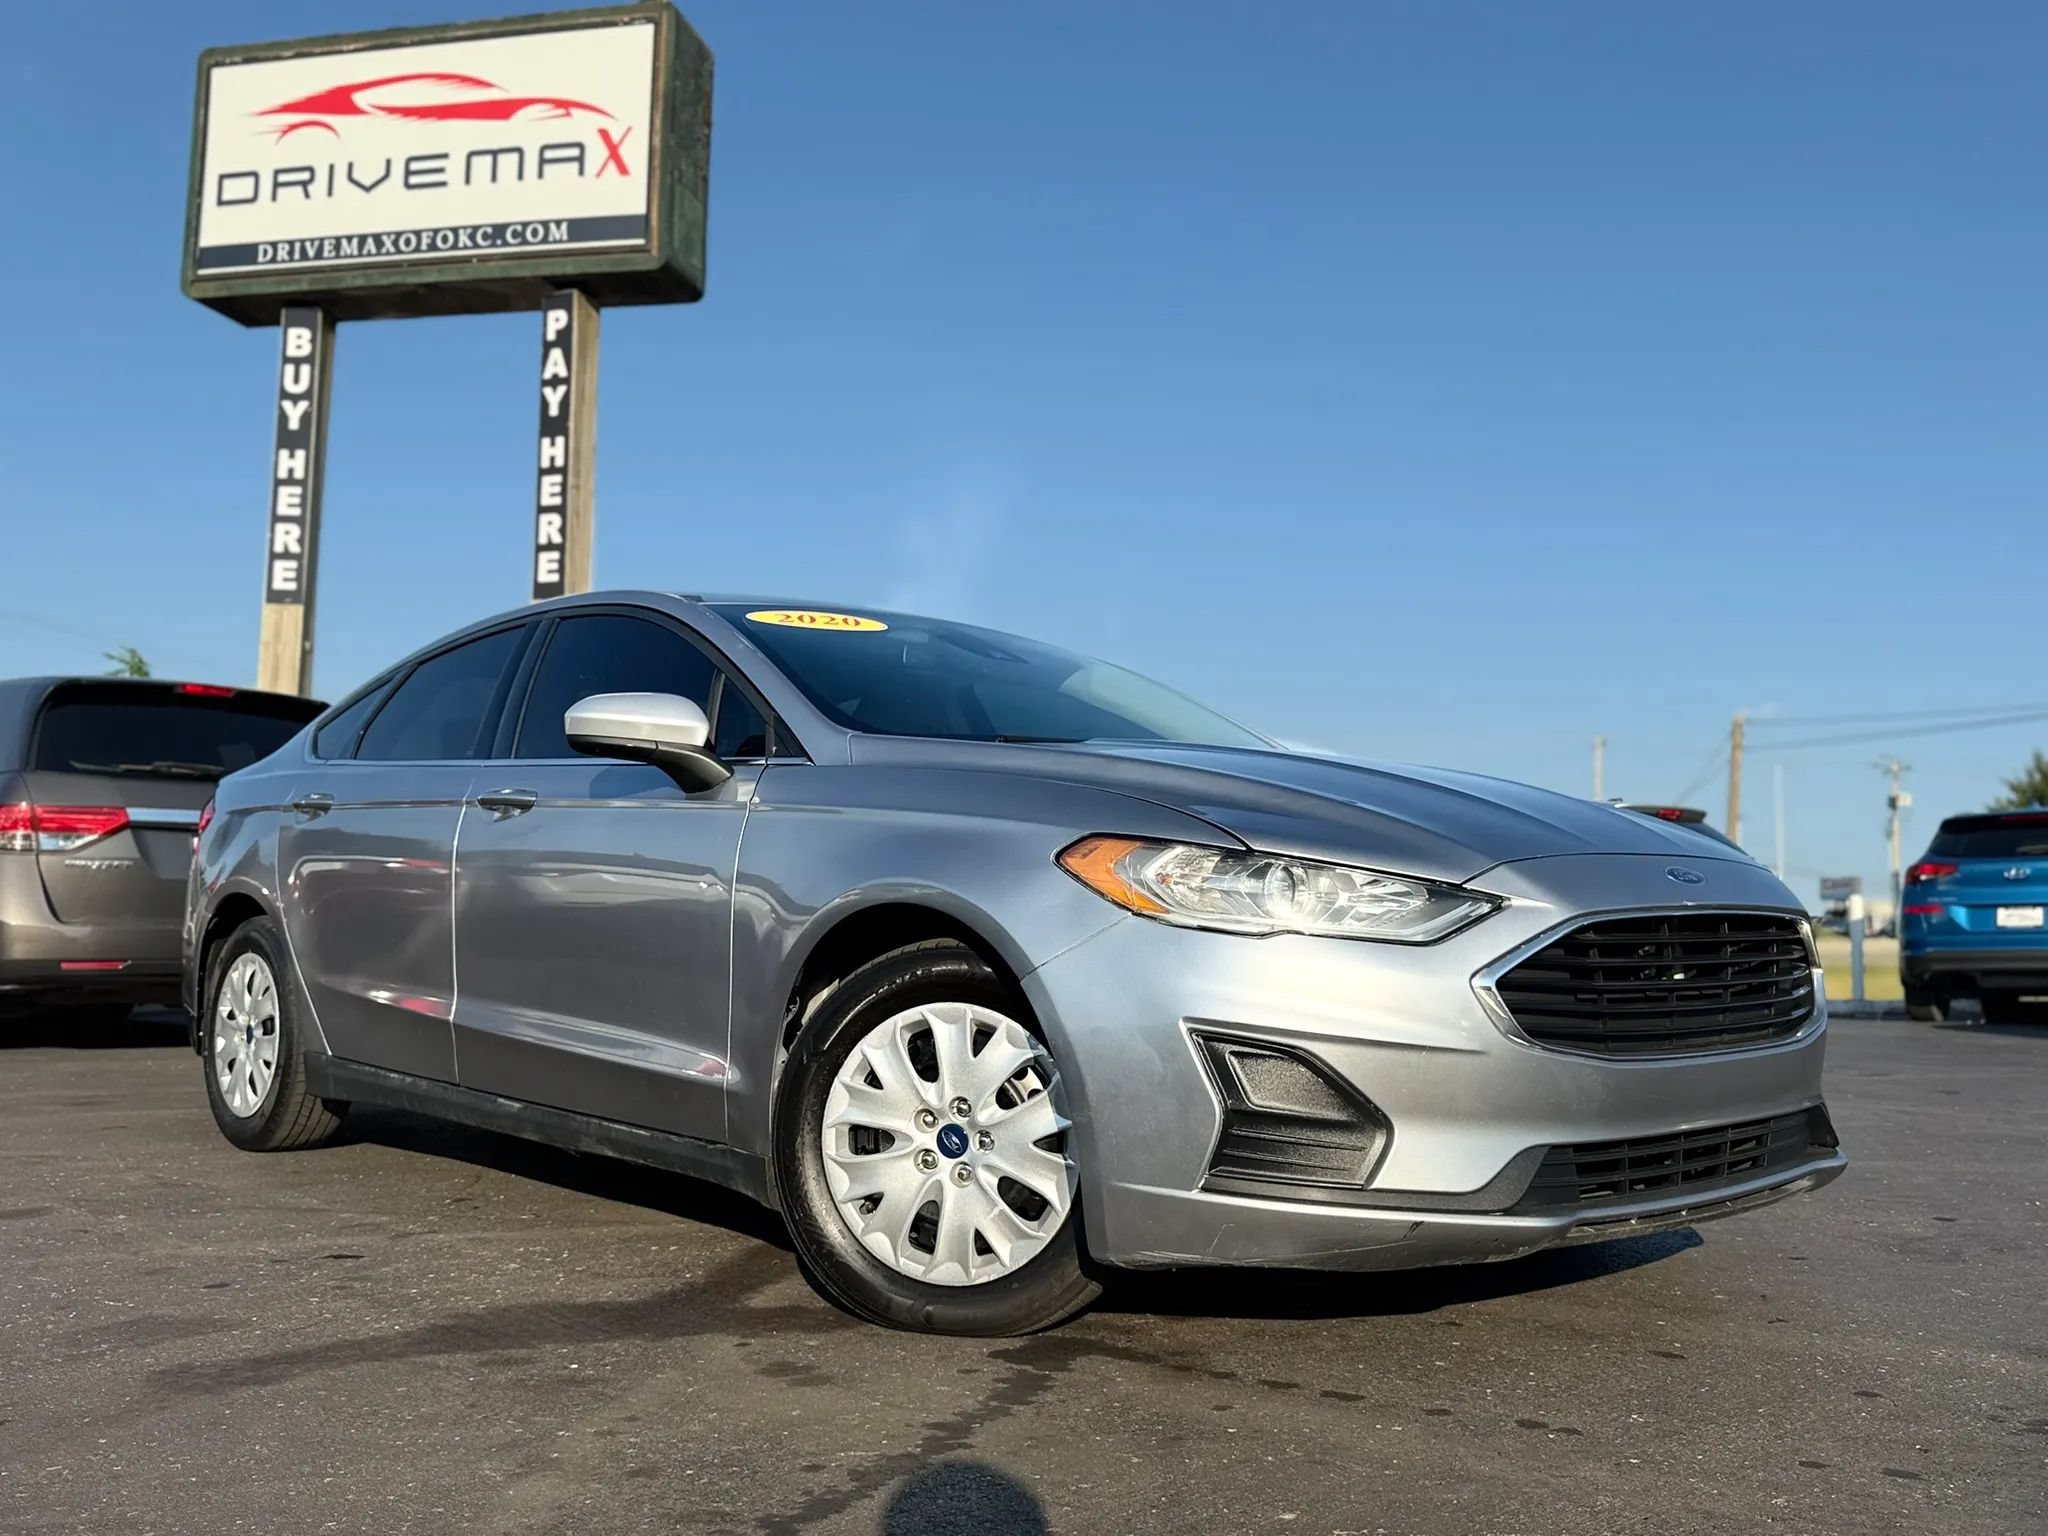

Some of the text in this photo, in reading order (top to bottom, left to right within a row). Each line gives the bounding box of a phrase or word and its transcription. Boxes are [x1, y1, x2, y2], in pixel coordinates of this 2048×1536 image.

[216, 125, 632, 207] DRIVEMAX
[256, 221, 570, 265] DRIVEMAXOFOKC.COM
[271, 326, 313, 591] BUY HERE
[536, 308, 569, 584] PAY HERE
[774, 613, 862, 627] 2020
